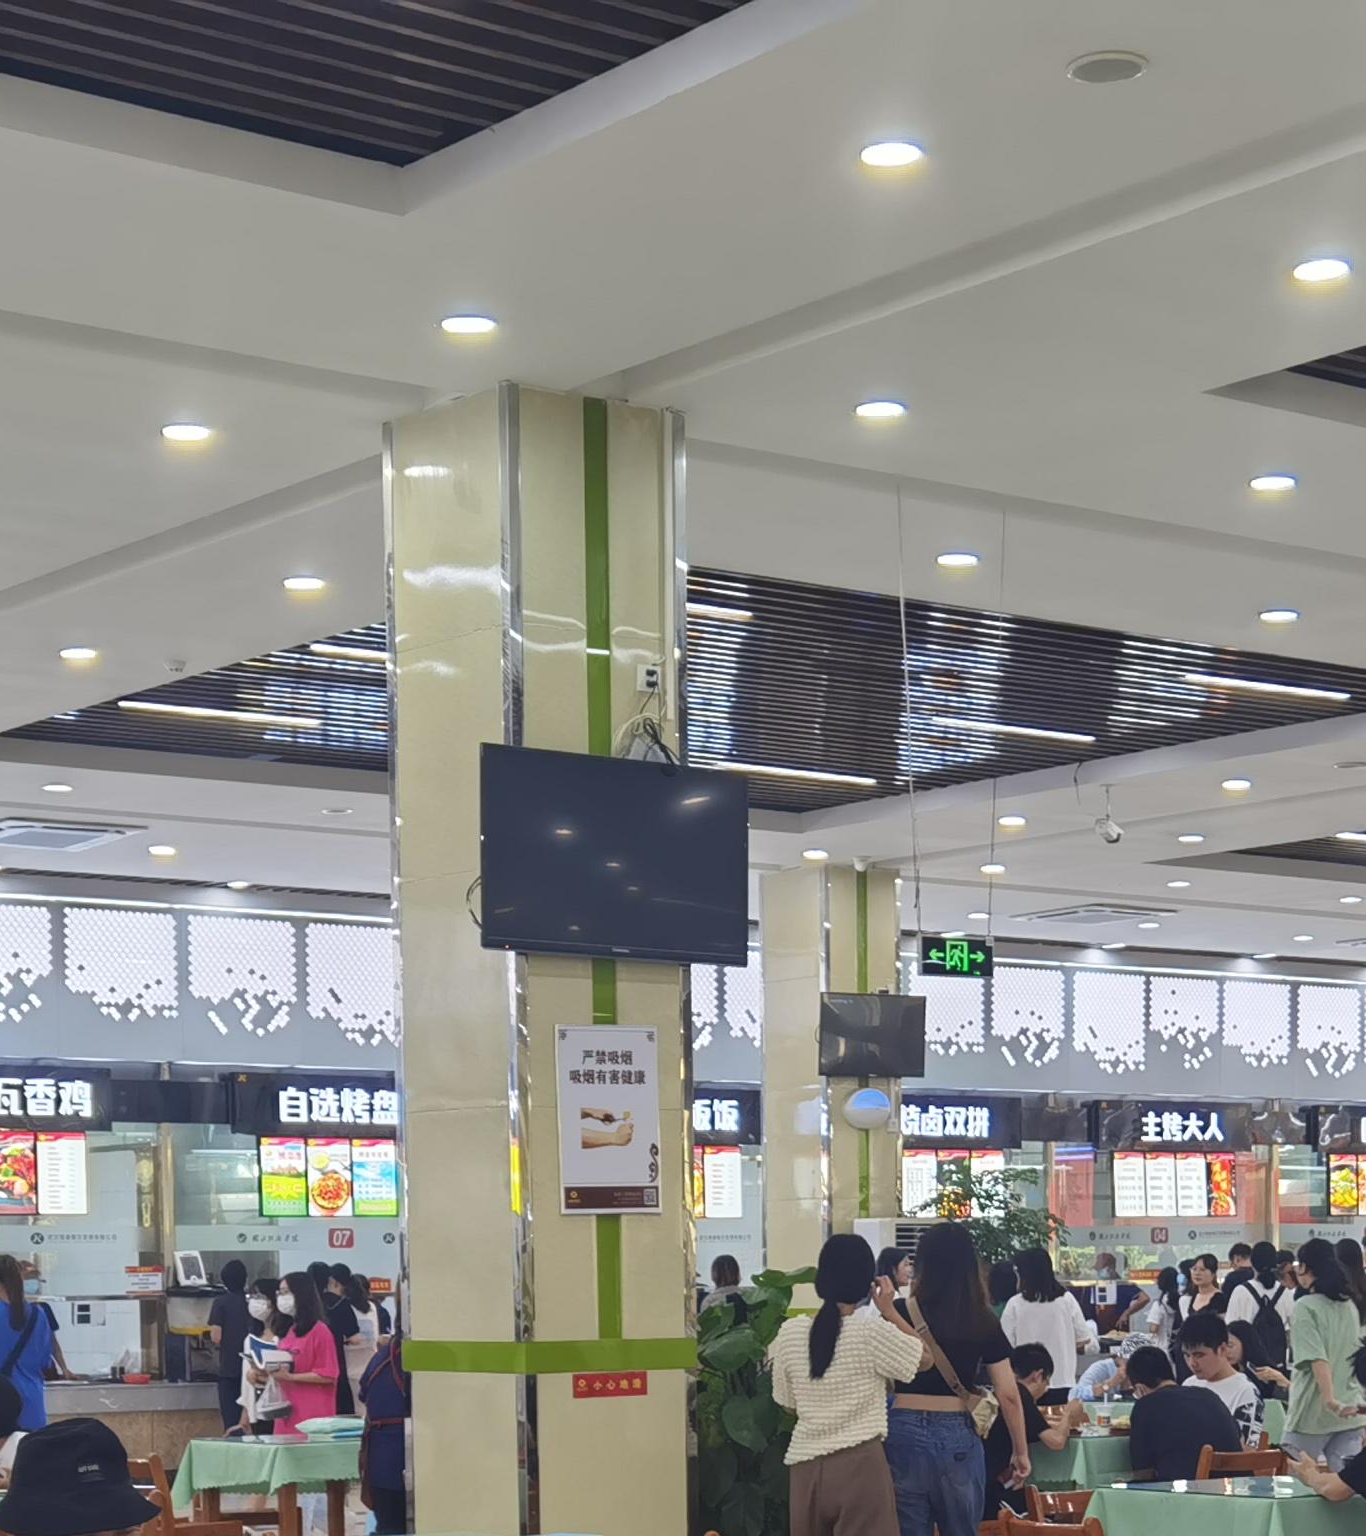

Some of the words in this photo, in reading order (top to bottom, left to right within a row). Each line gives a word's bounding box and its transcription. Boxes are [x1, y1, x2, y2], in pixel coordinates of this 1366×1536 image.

[582, 1049, 633, 1066] 严禁吸烟
[569, 1069, 646, 1086] 吸烟有害健康
[279, 1086, 398, 1124] 自选烤盘
[1141, 1111, 1224, 1142] 主烤大人
[332, 1230, 350, 1247] 07
